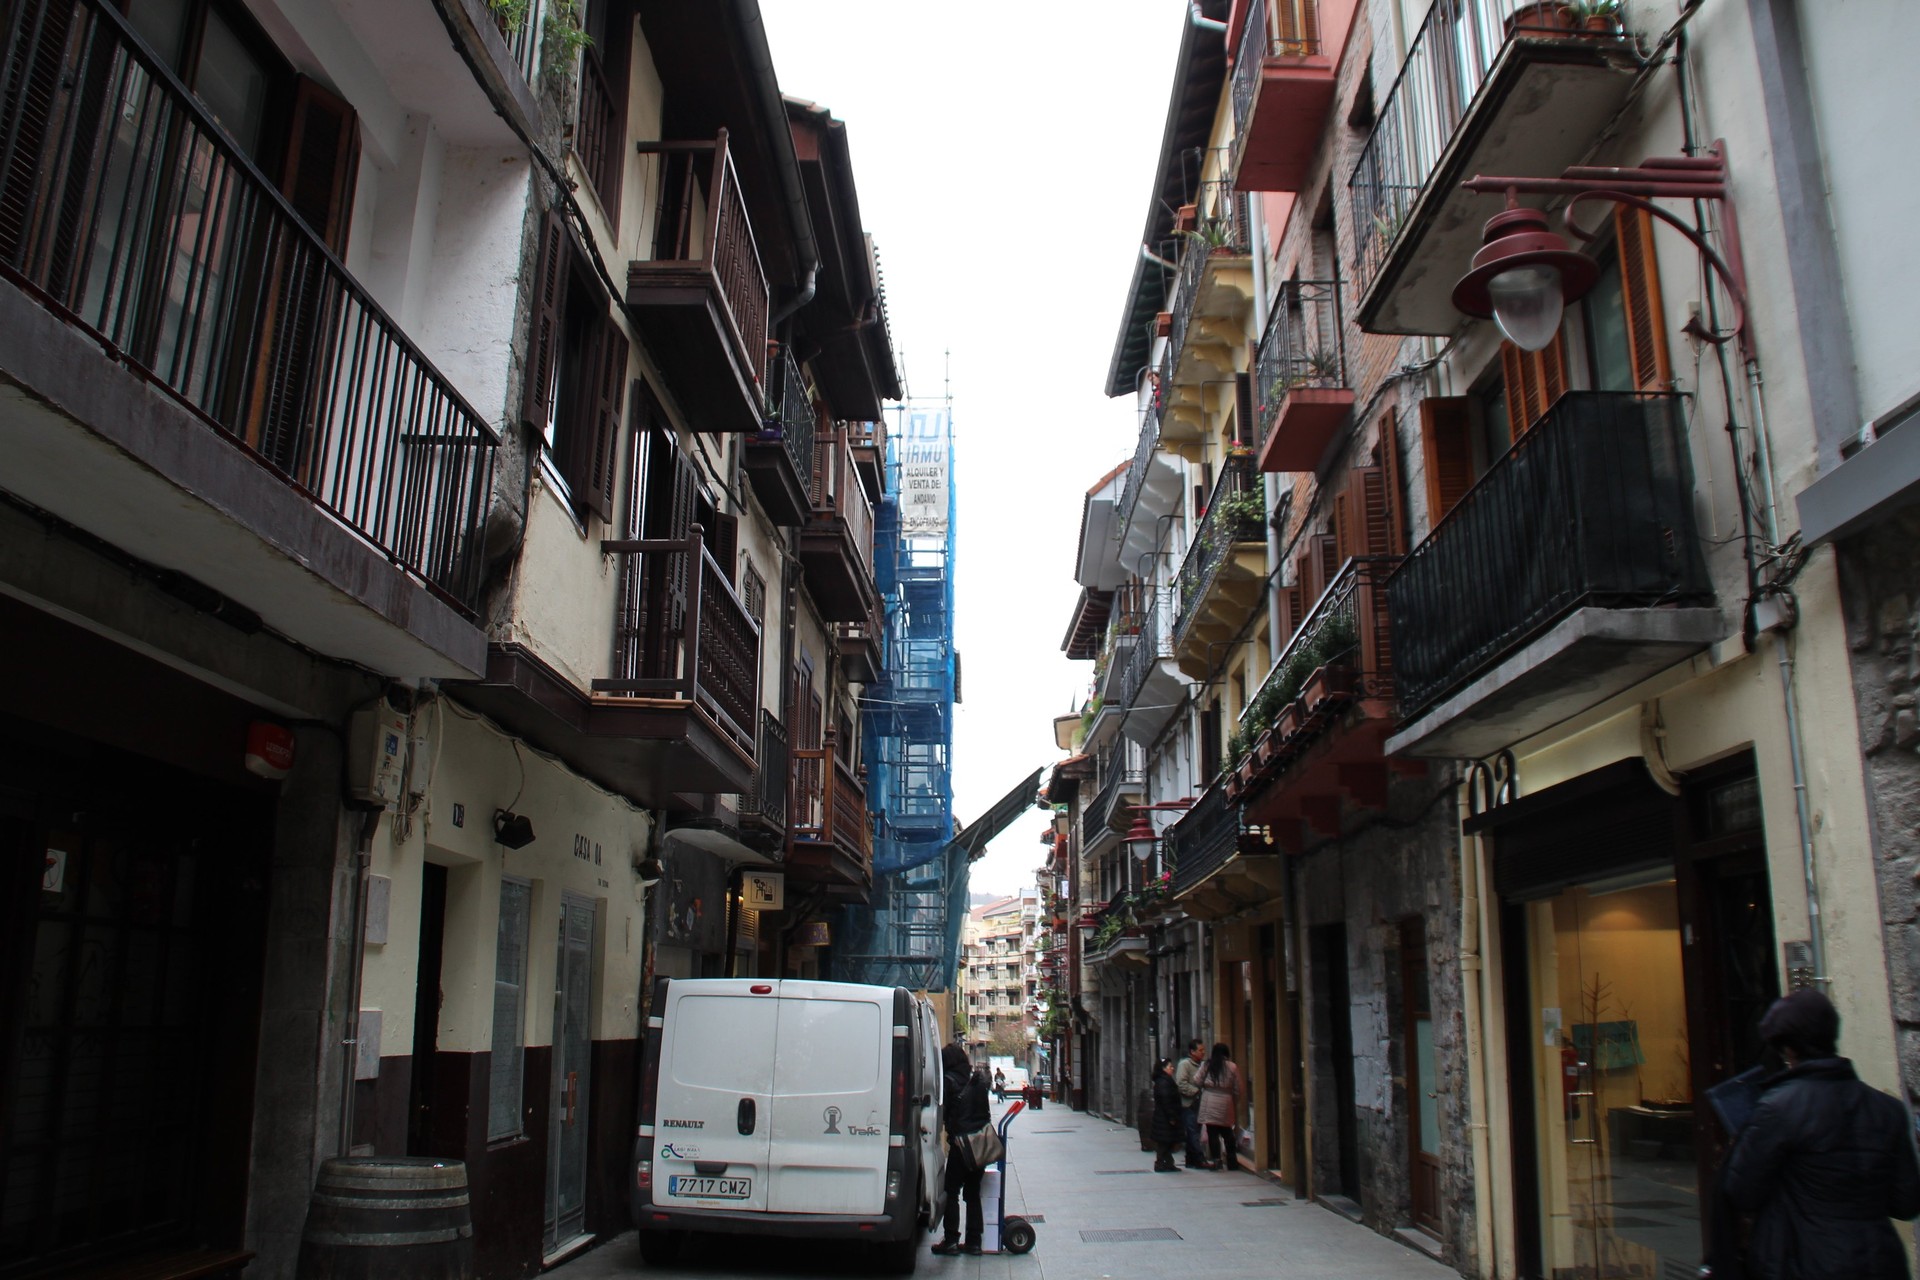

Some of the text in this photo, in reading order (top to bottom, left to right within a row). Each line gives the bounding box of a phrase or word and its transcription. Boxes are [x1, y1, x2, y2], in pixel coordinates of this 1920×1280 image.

[906, 467, 944, 477] ALQUILER Y
[909, 480, 941, 489] VENTA DE:
[924, 505, 928, 515] Y
[573, 833, 591, 862] CASA
[663, 1119, 705, 1129] RENAULT
[848, 1125, 881, 1136] Trafic
[679, 1178, 747, 1195] 7717 CMZ
